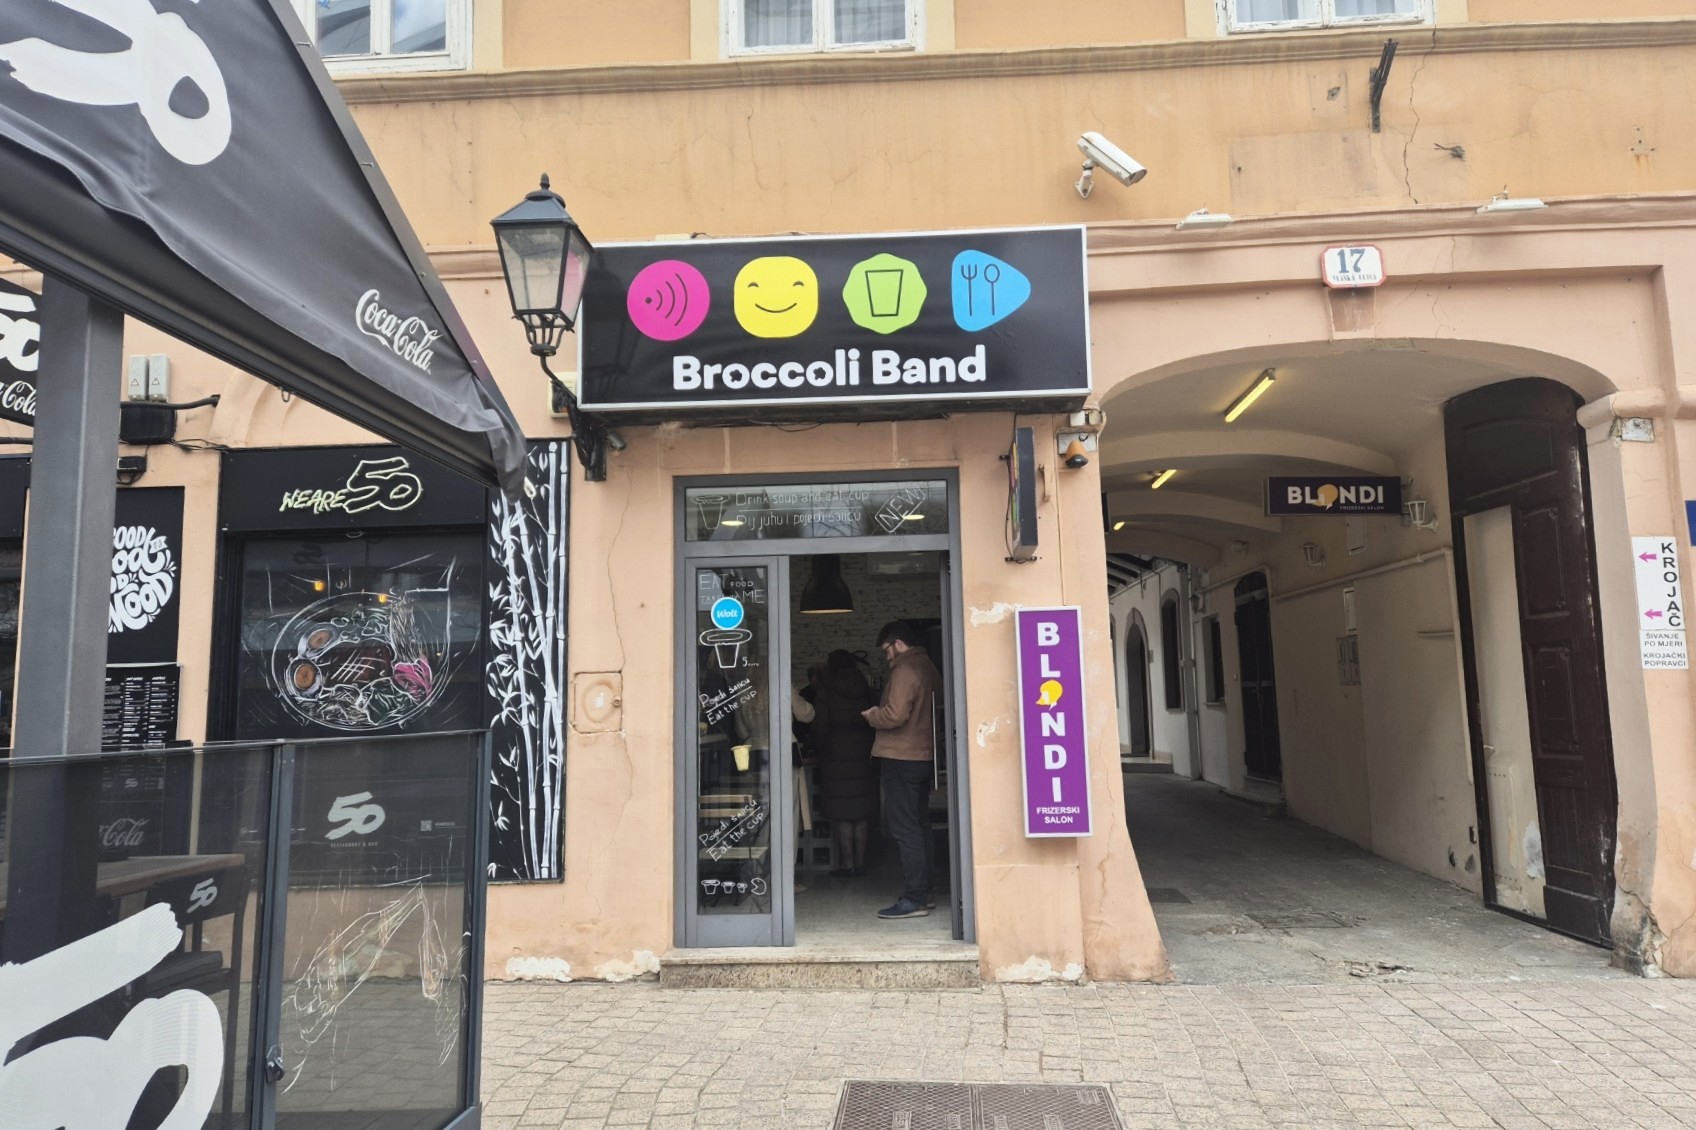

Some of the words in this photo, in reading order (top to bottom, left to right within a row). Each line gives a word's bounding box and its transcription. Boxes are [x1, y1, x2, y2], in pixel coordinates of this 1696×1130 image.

[1337, 248, 1365, 273] 17
[355, 289, 443, 374] Coca-Cola
[673, 348, 860, 391] Broccoli
[872, 344, 987, 385] Band
[343, 456, 422, 513] 50
[735, 492, 769, 507] Drink
[773, 494, 798, 505] soup
[801, 490, 822, 503] and
[879, 487, 921, 528] NEW
[114, 525, 147, 550] OOD
[700, 573, 729, 590] EAT
[1661, 542, 1682, 628] KROJAČ
[717, 609, 739, 619] Wolt
[1645, 632, 1680, 640] ŠIVANJE
[1657, 640, 1683, 648] MJERI
[742, 656, 749, 668] 5
[707, 710, 725, 726] Eat
[723, 701, 739, 713] the
[324, 791, 386, 841] 50
[1036, 806, 1081, 816] FRIZERSKI
[1044, 816, 1074, 825] SALON
[698, 820, 729, 847] Pojedi
[708, 840, 733, 862] Eat
[729, 828, 747, 843] the
[186, 877, 218, 914] 50
